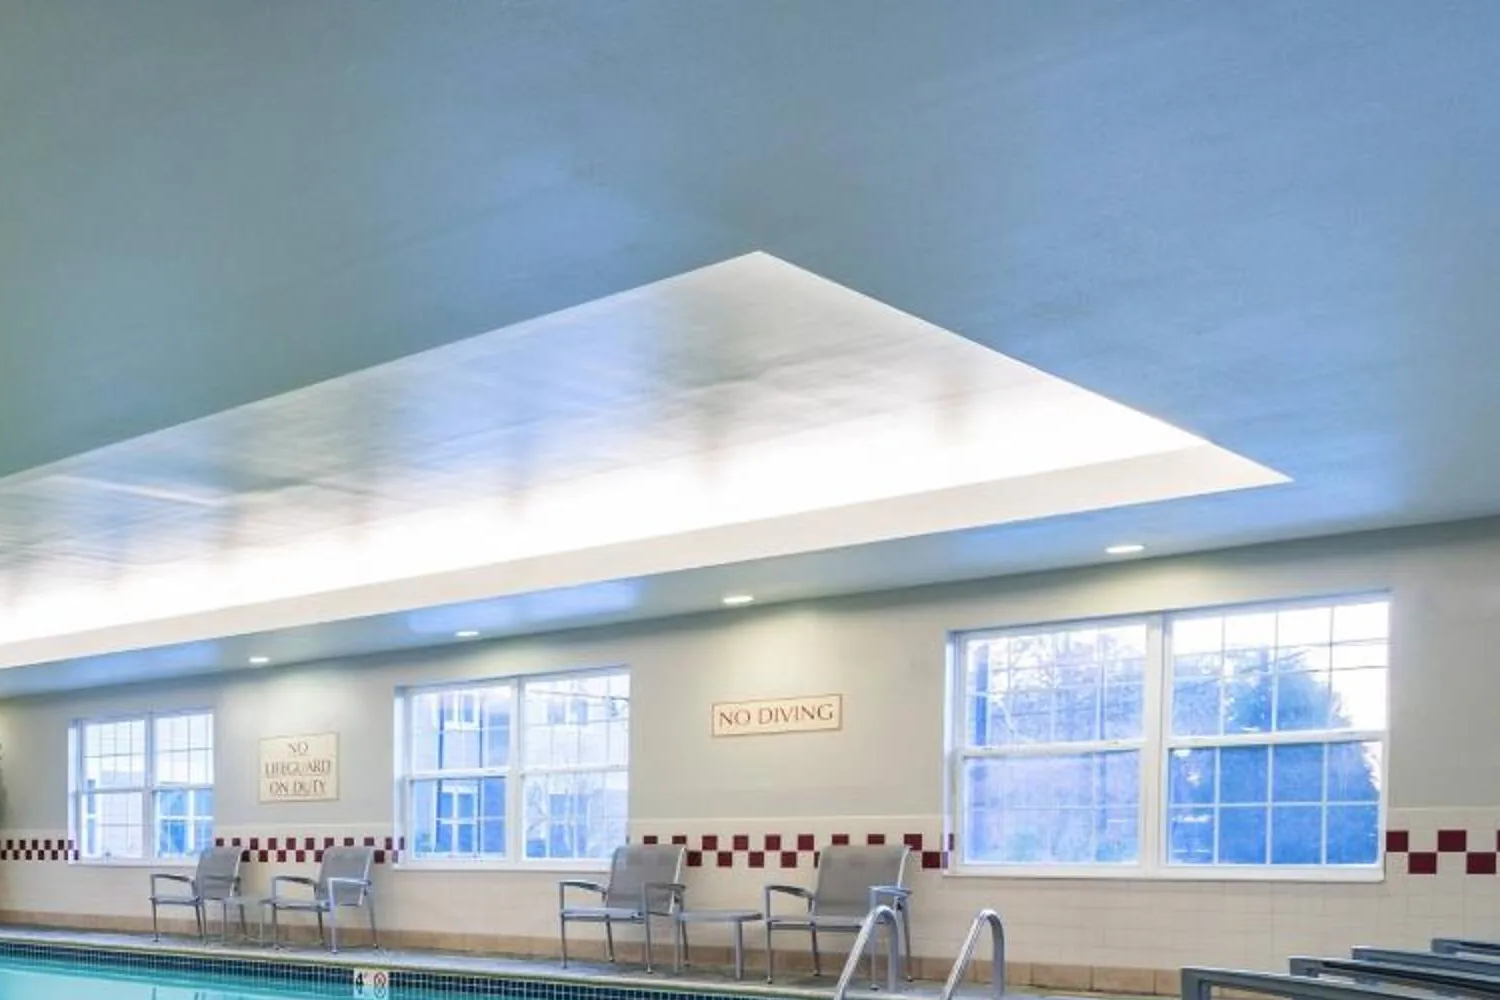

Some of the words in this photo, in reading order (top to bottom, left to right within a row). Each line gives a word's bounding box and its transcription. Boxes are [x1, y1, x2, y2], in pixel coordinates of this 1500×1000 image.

[719, 709, 751, 728] NO
[758, 703, 834, 725] DIVING
[287, 741, 309, 756] NO
[269, 781, 289, 797] ON
